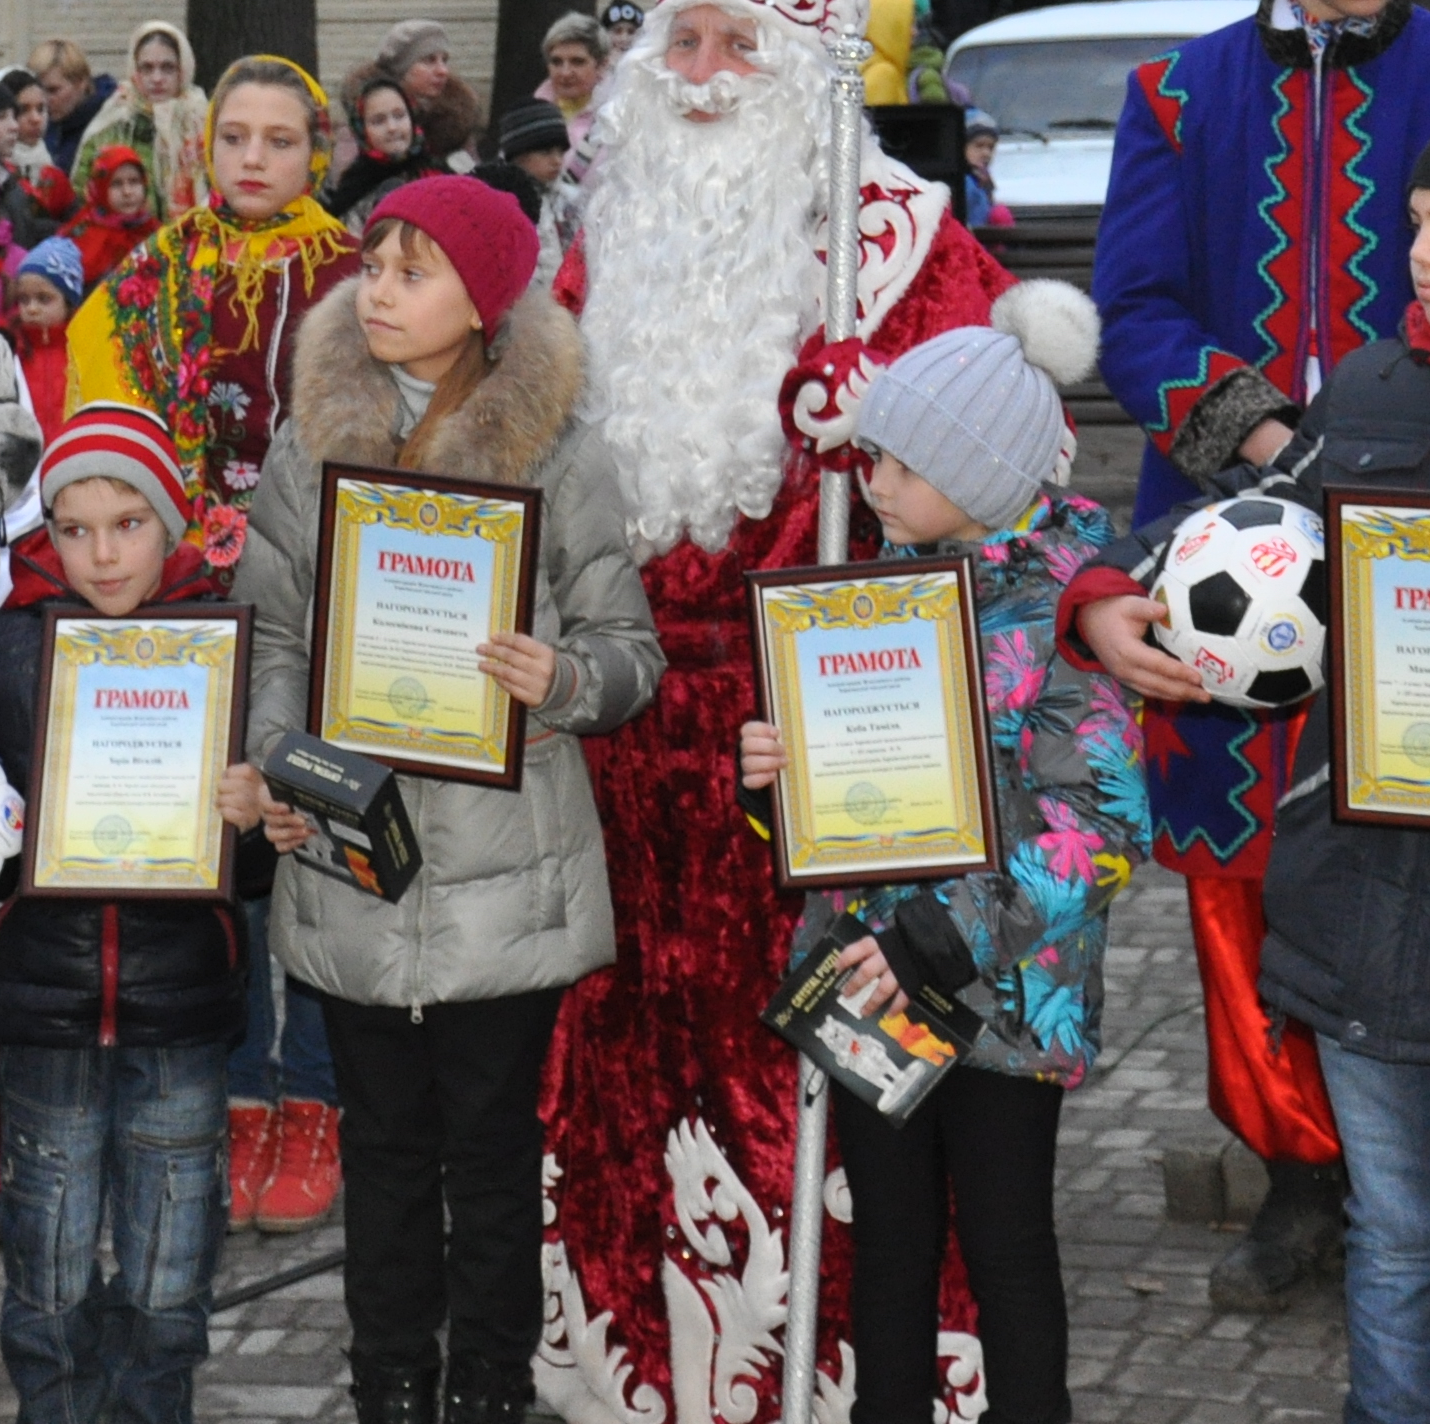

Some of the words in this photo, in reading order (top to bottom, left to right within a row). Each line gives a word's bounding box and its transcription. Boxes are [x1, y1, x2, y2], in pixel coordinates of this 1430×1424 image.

[378, 551, 474, 582] ГРАМОТА
[818, 648, 921, 675] ГРАМОТА
[95, 690, 189, 709] ГРАМОТА
